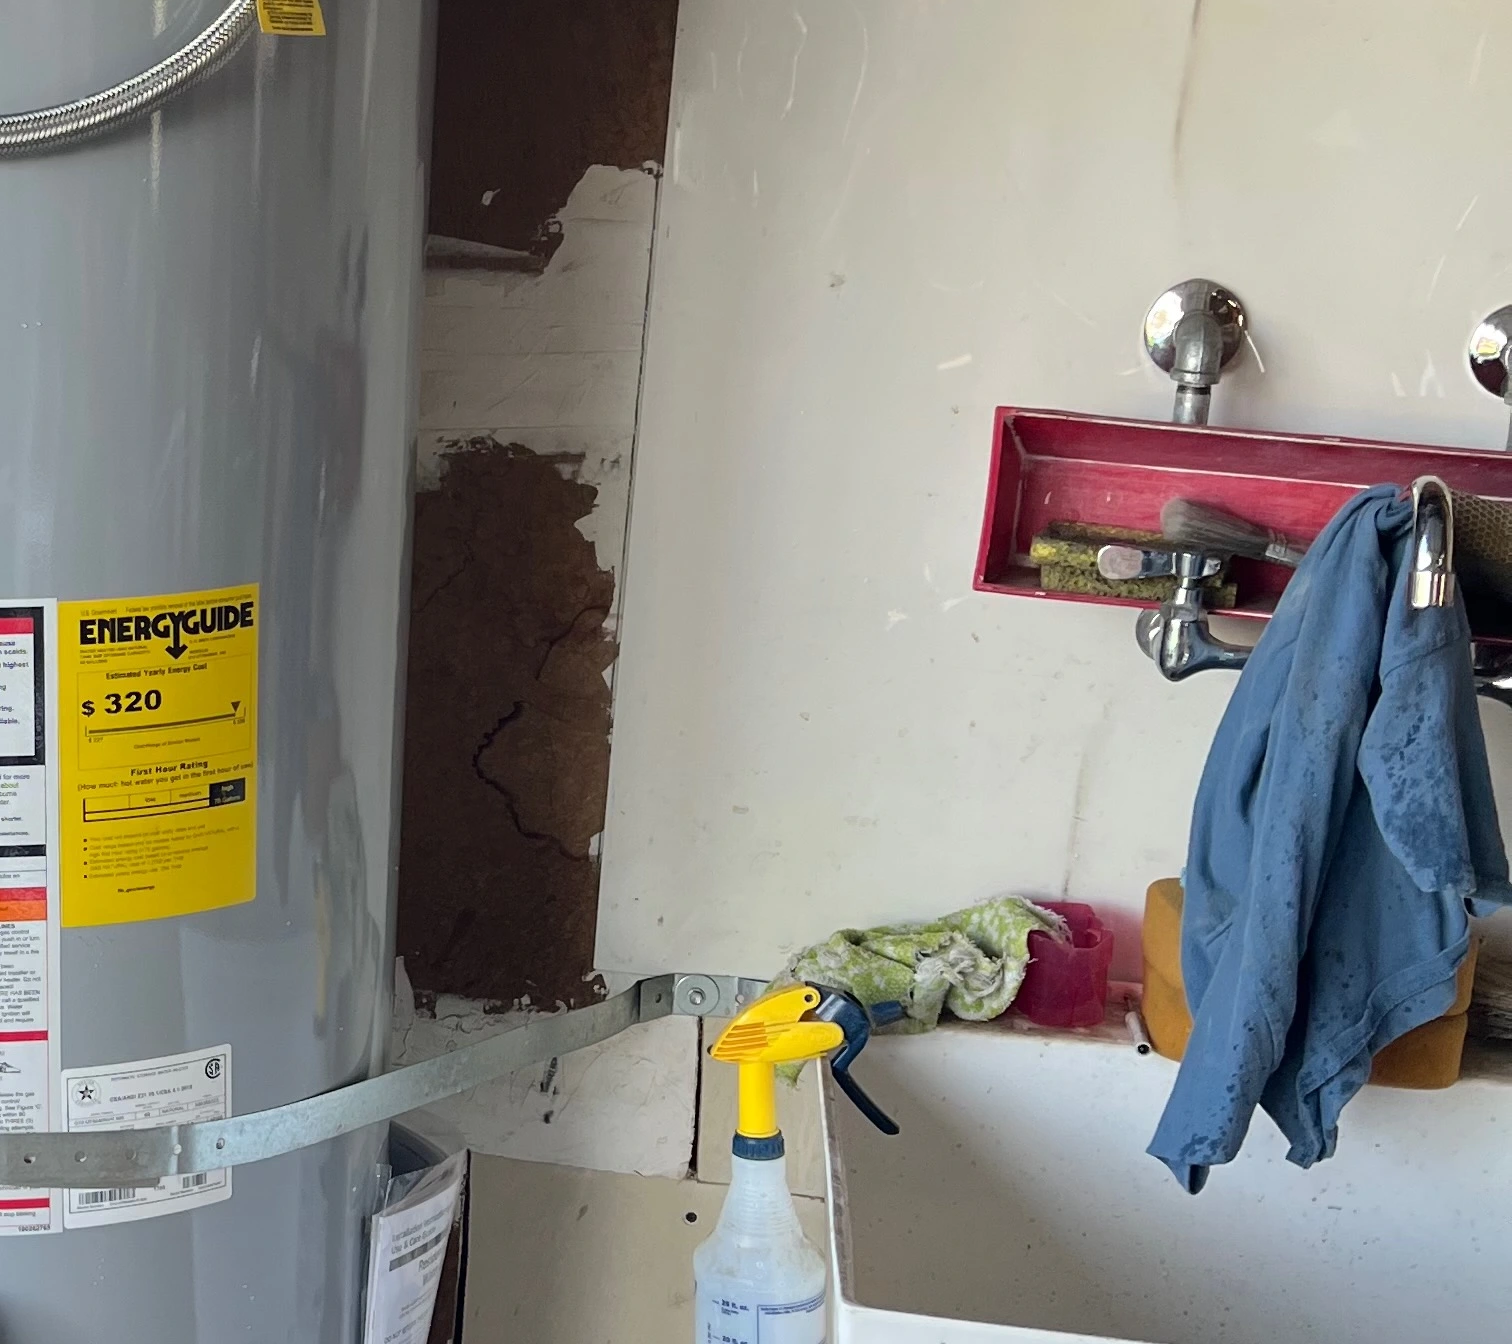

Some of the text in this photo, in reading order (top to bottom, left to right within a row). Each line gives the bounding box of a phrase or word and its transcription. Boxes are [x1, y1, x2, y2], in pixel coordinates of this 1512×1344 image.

[80, 601, 254, 645] ENERGYGUIDE
[106, 663, 208, 680] Estimated Yearly Energy Cost
[81, 690, 162, 717] $ 320
[131, 761, 208, 776] First Hour Rating
